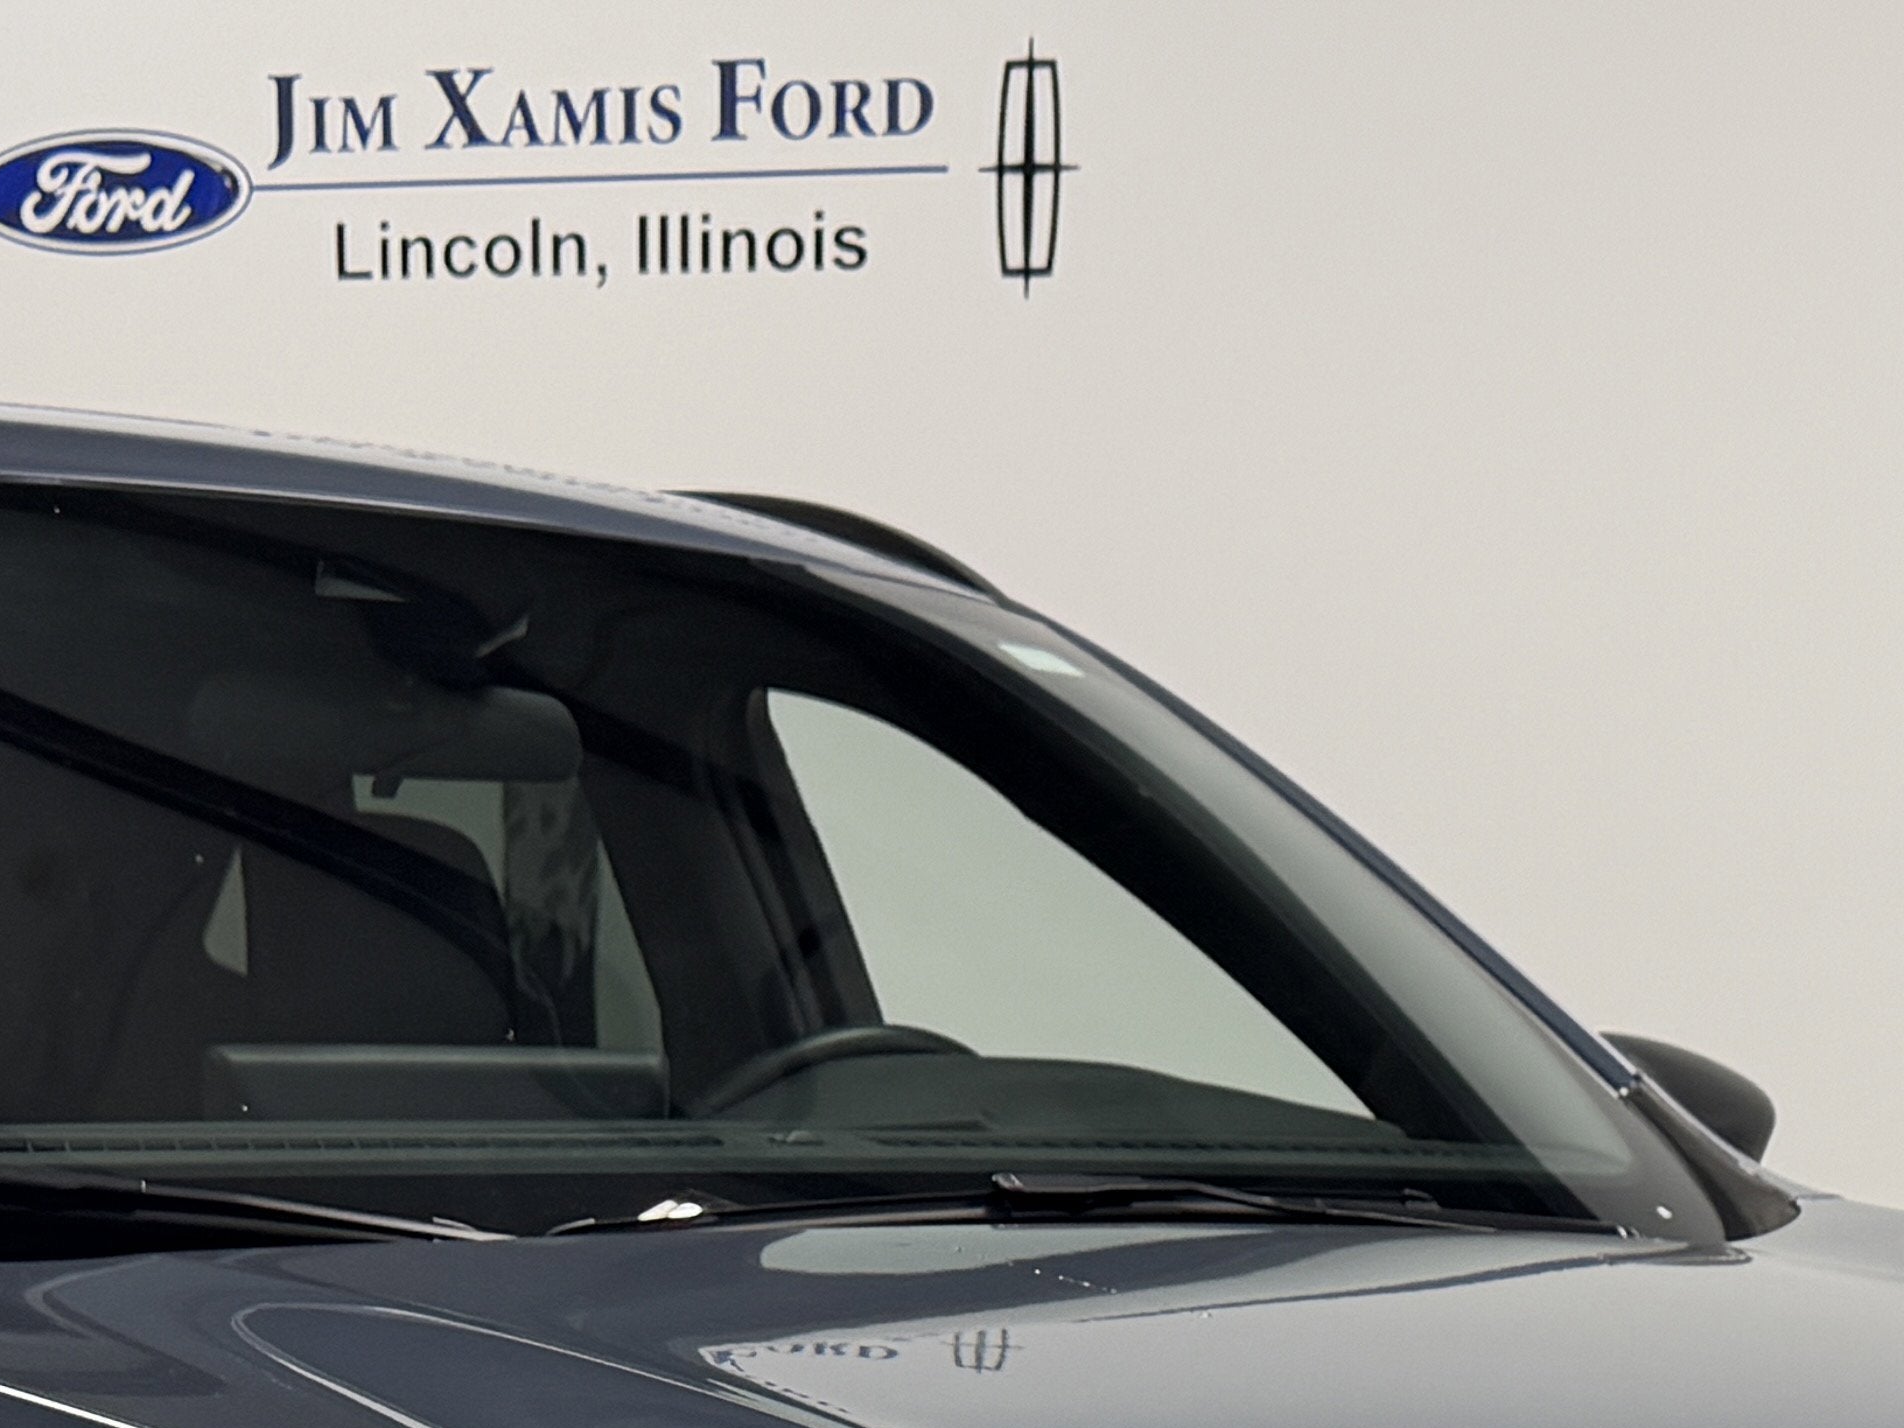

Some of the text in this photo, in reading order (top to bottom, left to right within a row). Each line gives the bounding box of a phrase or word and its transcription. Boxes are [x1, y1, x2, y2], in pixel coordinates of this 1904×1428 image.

[267, 57, 936, 171] JIM XAMIS FORD
[19, 149, 195, 234] Ford
[336, 210, 869, 288] Lincoln, Illinois
